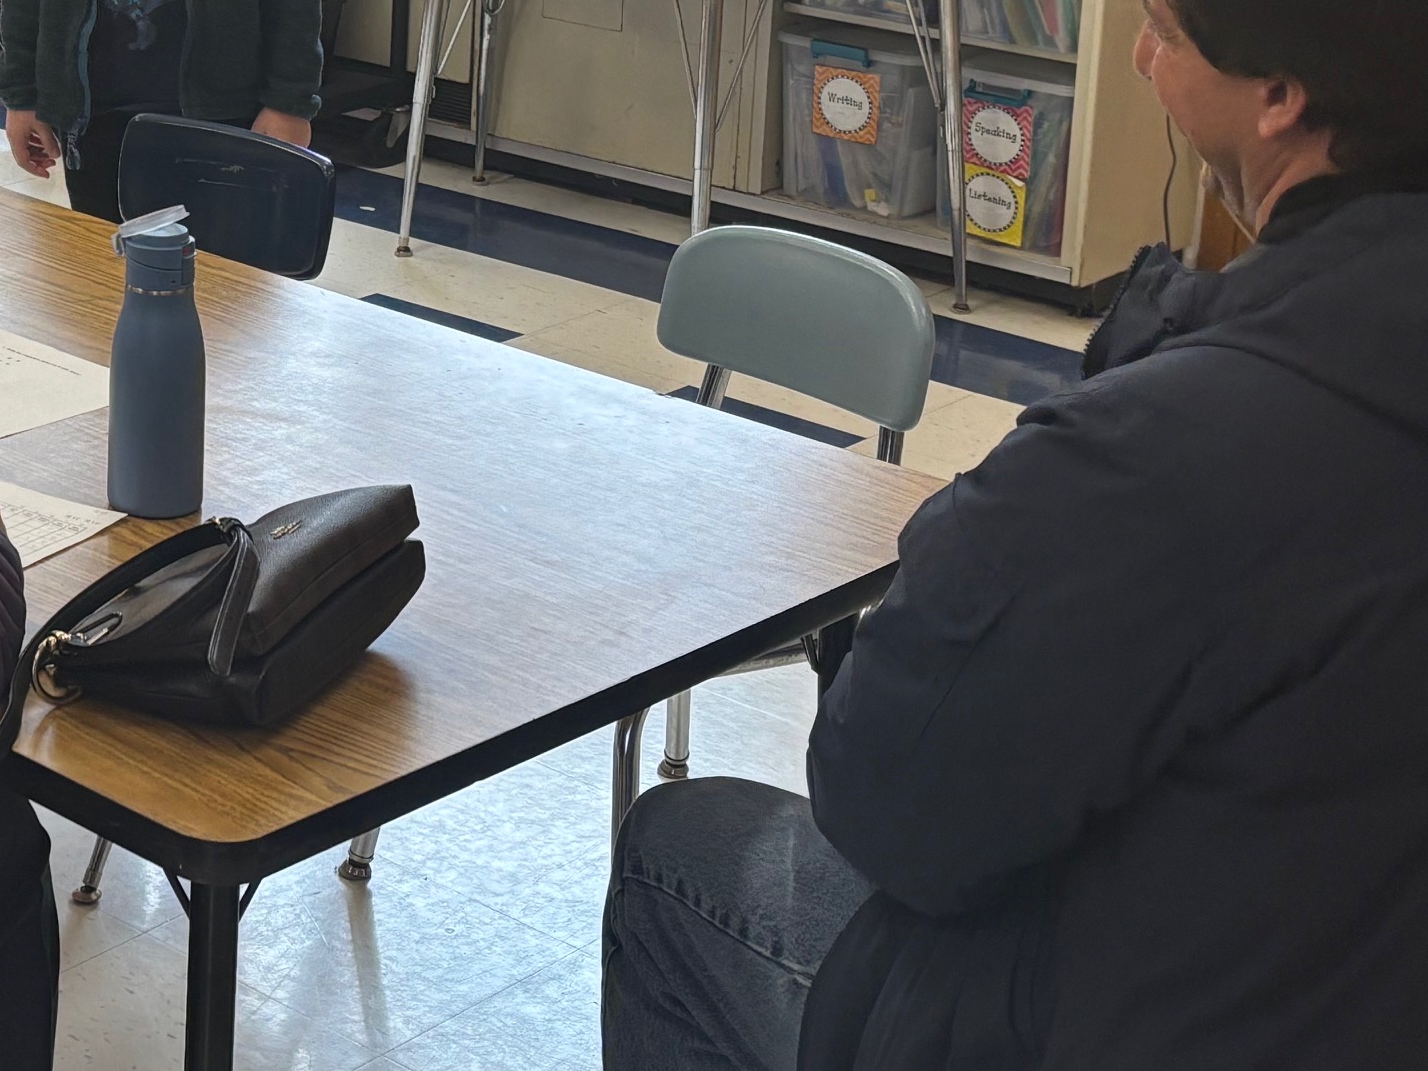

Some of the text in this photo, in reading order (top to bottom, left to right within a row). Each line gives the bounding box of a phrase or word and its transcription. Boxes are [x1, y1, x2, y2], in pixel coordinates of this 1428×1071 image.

[827, 91, 864, 111] Writing
[974, 122, 1018, 144] Speaking
[968, 188, 1012, 210] Listening
